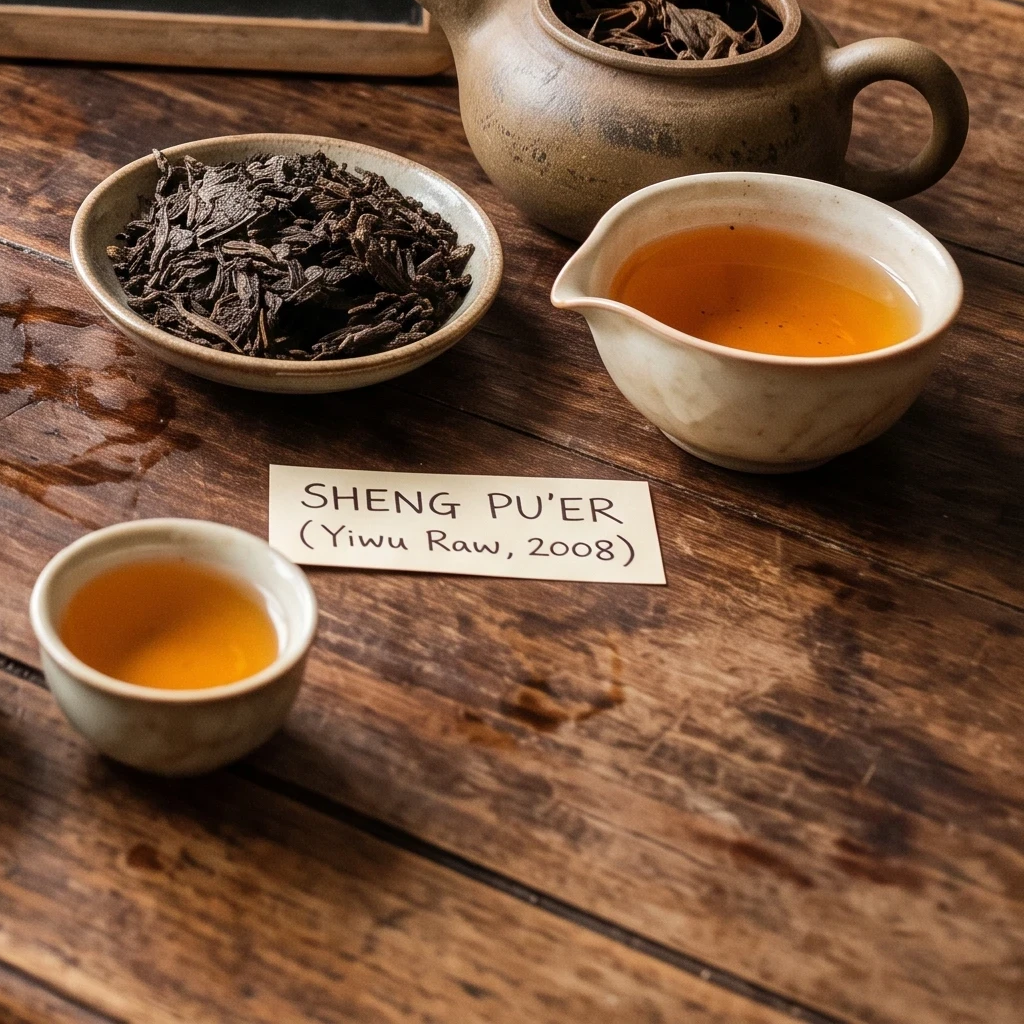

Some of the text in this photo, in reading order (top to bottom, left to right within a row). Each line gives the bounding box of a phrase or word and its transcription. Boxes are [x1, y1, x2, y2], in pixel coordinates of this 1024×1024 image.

[300, 482, 624, 525] SHENG PU'ER
[299, 519, 636, 568] (Yiwu Raw, 2008)
